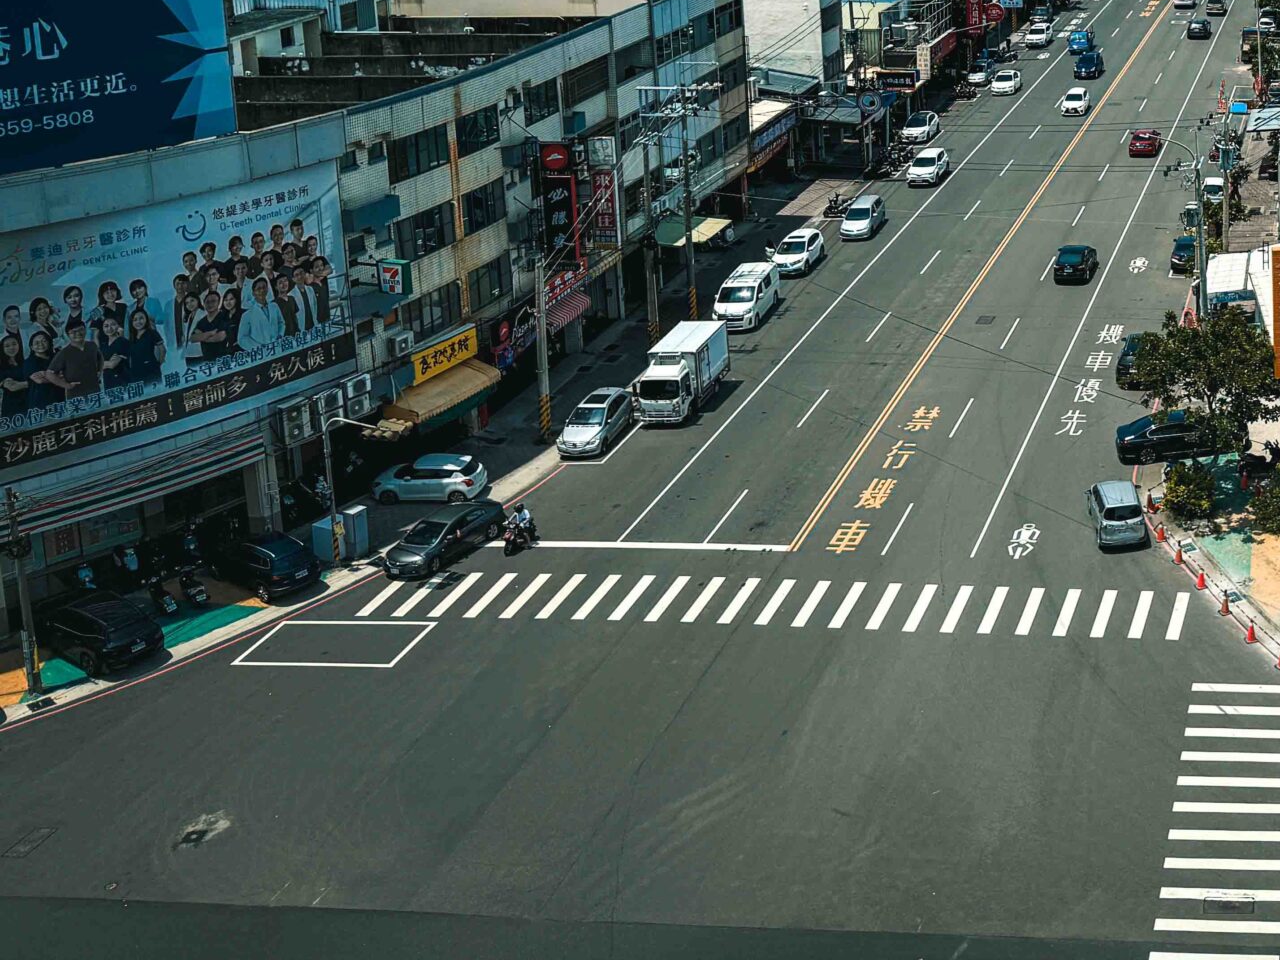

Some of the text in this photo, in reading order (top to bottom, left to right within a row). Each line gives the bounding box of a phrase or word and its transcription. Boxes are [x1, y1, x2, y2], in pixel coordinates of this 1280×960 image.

[255, 208, 282, 222] Dental
[82, 245, 149, 266] DENTAL CLINIC
[1055, 324, 1125, 436] 機車優先
[825, 406, 941, 555] 禁行機車
